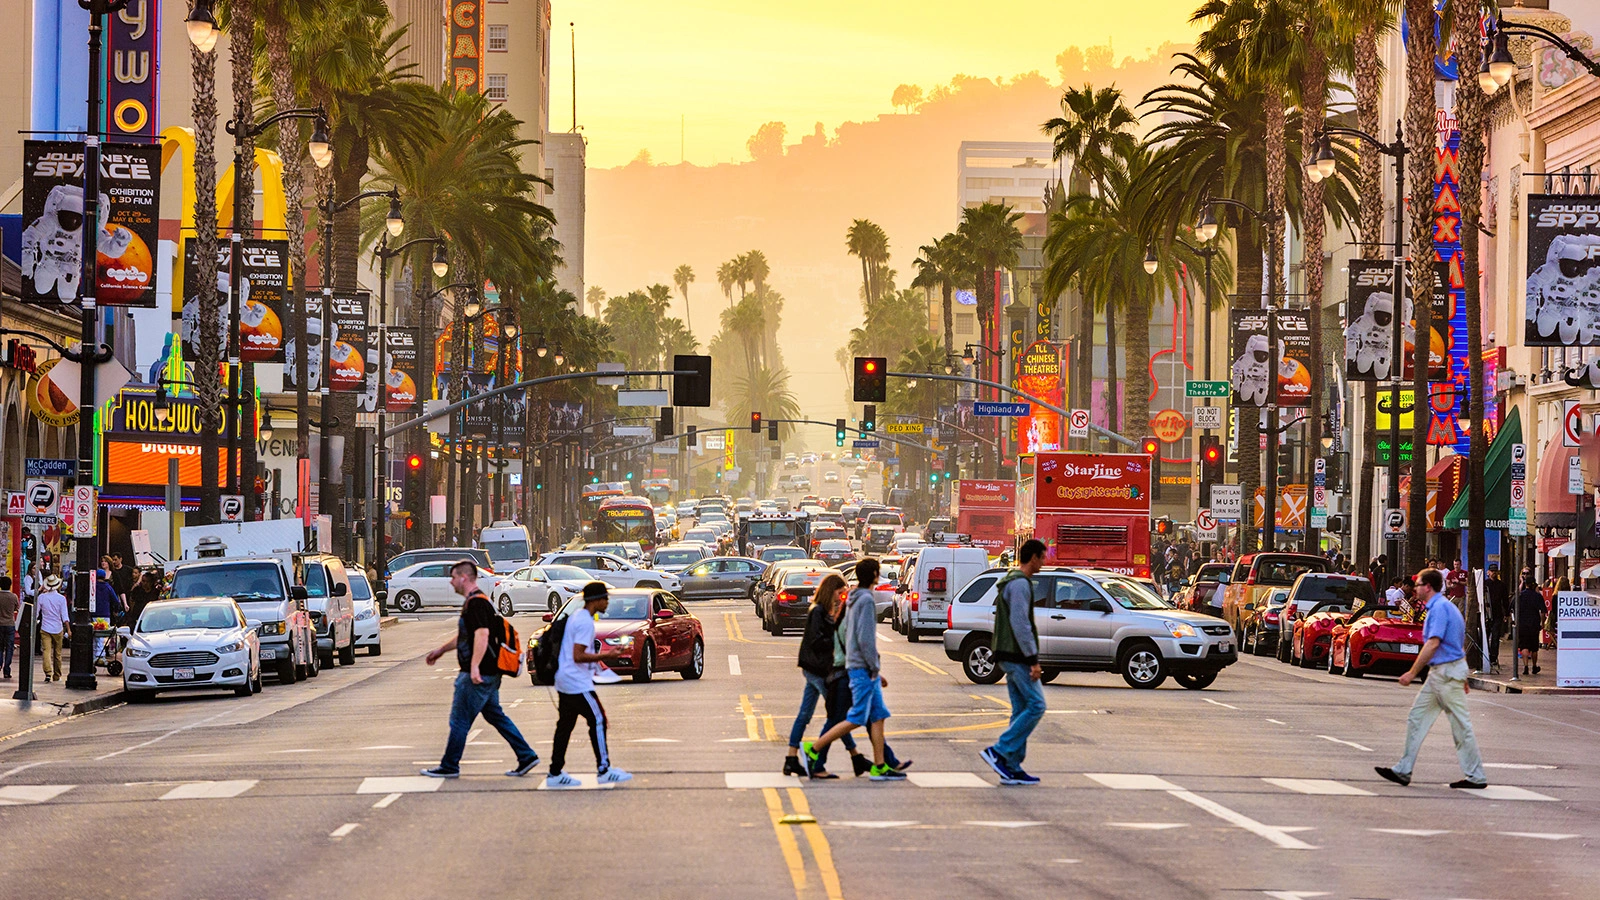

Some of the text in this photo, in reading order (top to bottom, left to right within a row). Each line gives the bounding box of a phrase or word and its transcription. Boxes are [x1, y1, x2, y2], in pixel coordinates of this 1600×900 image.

[109, 187, 154, 197] EXHIBITION
[110, 196, 152, 205] & 3D FILM
[1035, 344, 1047, 353] TCL
[1026, 355, 1055, 364] CHINESE
[1024, 365, 1058, 374] THEATRES
[1192, 382, 1213, 390] Dolby
[978, 404, 1026, 415] Highland Av
[1148, 416, 1169, 429] ard
[27, 459, 67, 469] McCadden
[1216, 498, 1240, 506] MUST
[39, 516, 55, 524] HERE
[1485, 519, 1510, 528] GALORE
[1199, 531, 1216, 539] ON RED
